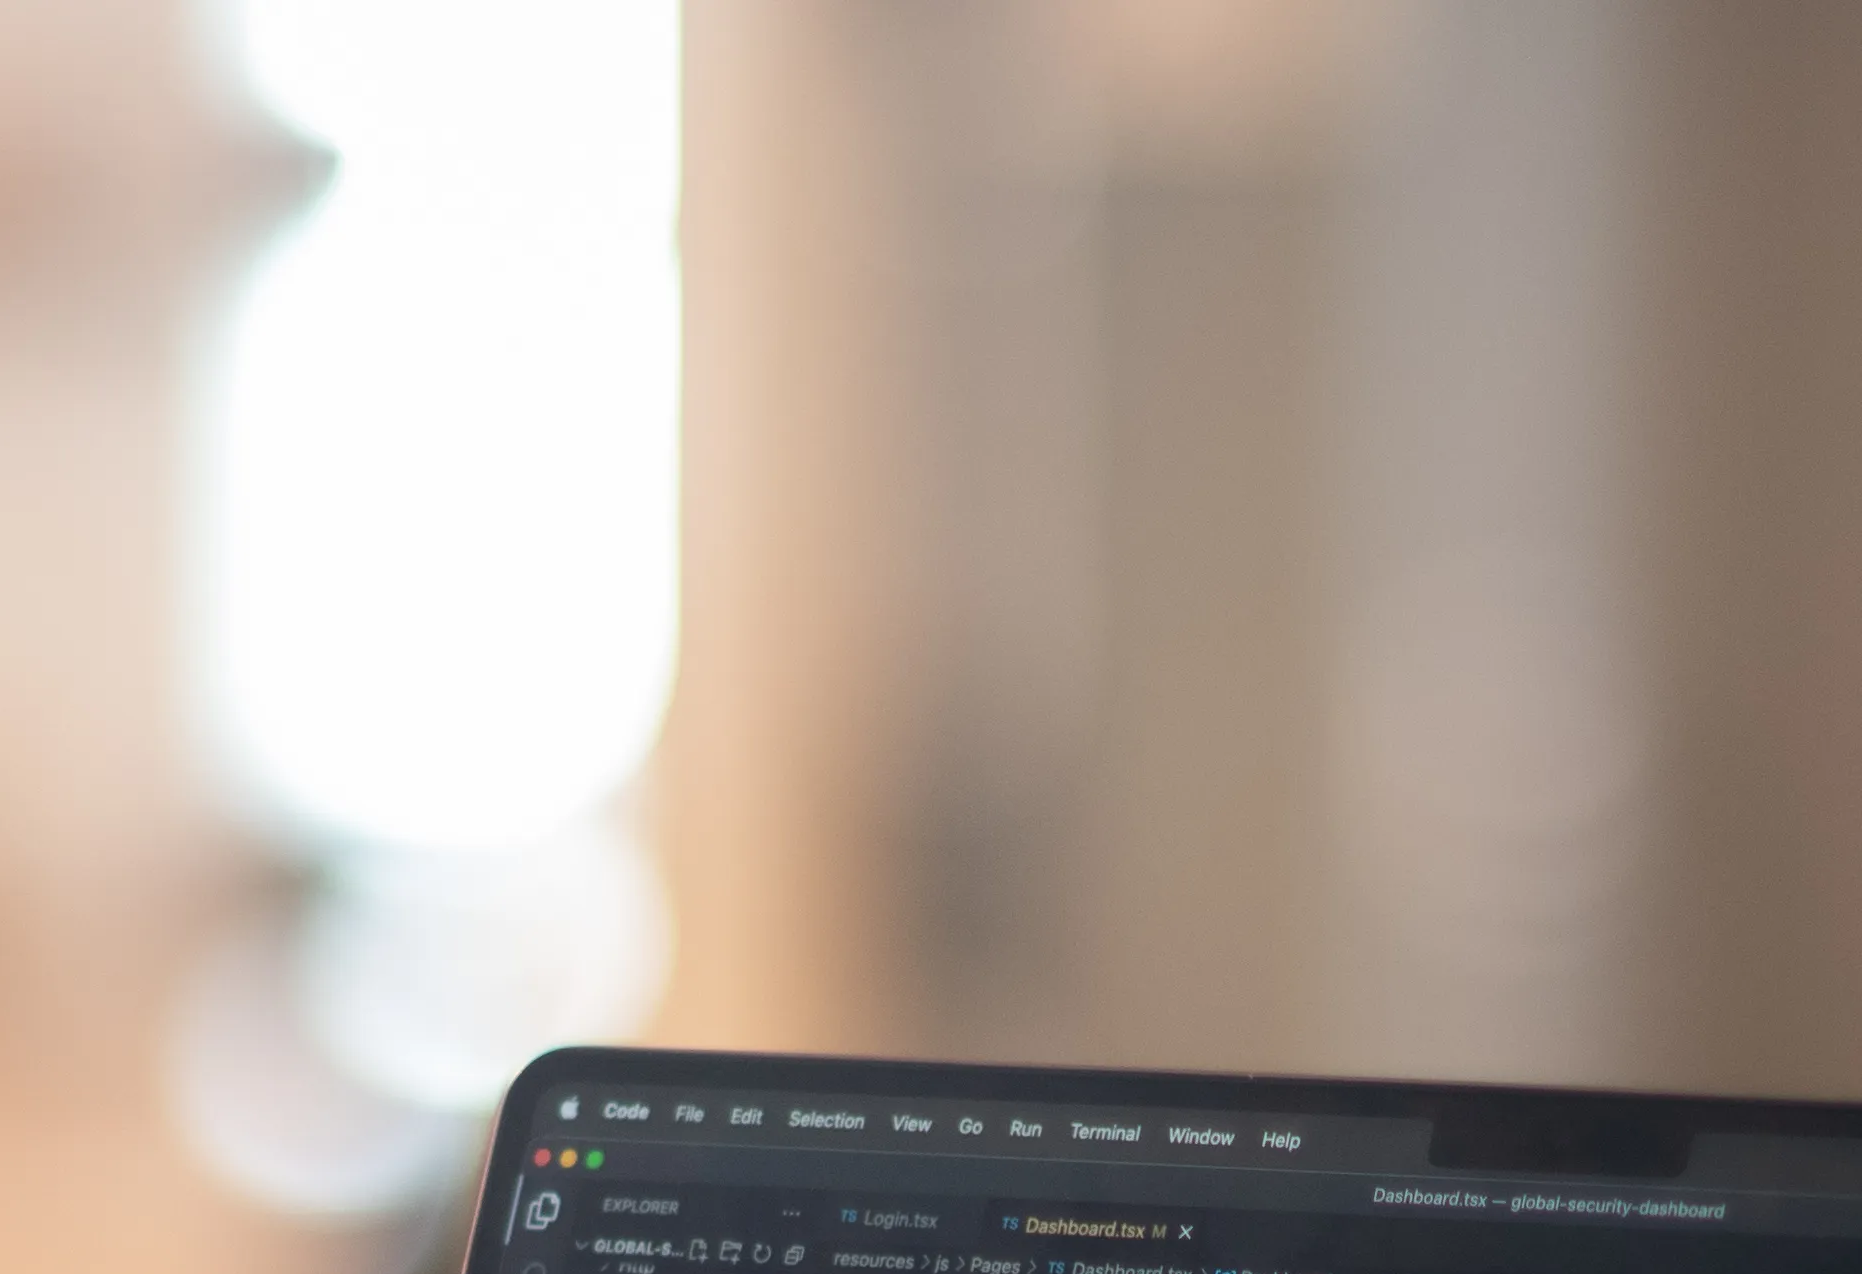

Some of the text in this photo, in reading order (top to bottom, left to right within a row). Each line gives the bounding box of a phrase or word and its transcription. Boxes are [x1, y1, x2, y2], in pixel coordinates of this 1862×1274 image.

[602, 1101, 1301, 1151] Code File Edit Selection View Go Run Terminal Window Help
[602, 1197, 679, 1215] EXPLORER
[1372, 1186, 1725, 1219] Dashboard.tsx global-security-dashboard
[863, 1209, 938, 1230] Login.tsx
[1025, 1216, 1167, 1238] Dashboard.tsx M
[833, 1252, 914, 1269] resources
[933, 1254, 949, 1273] js
